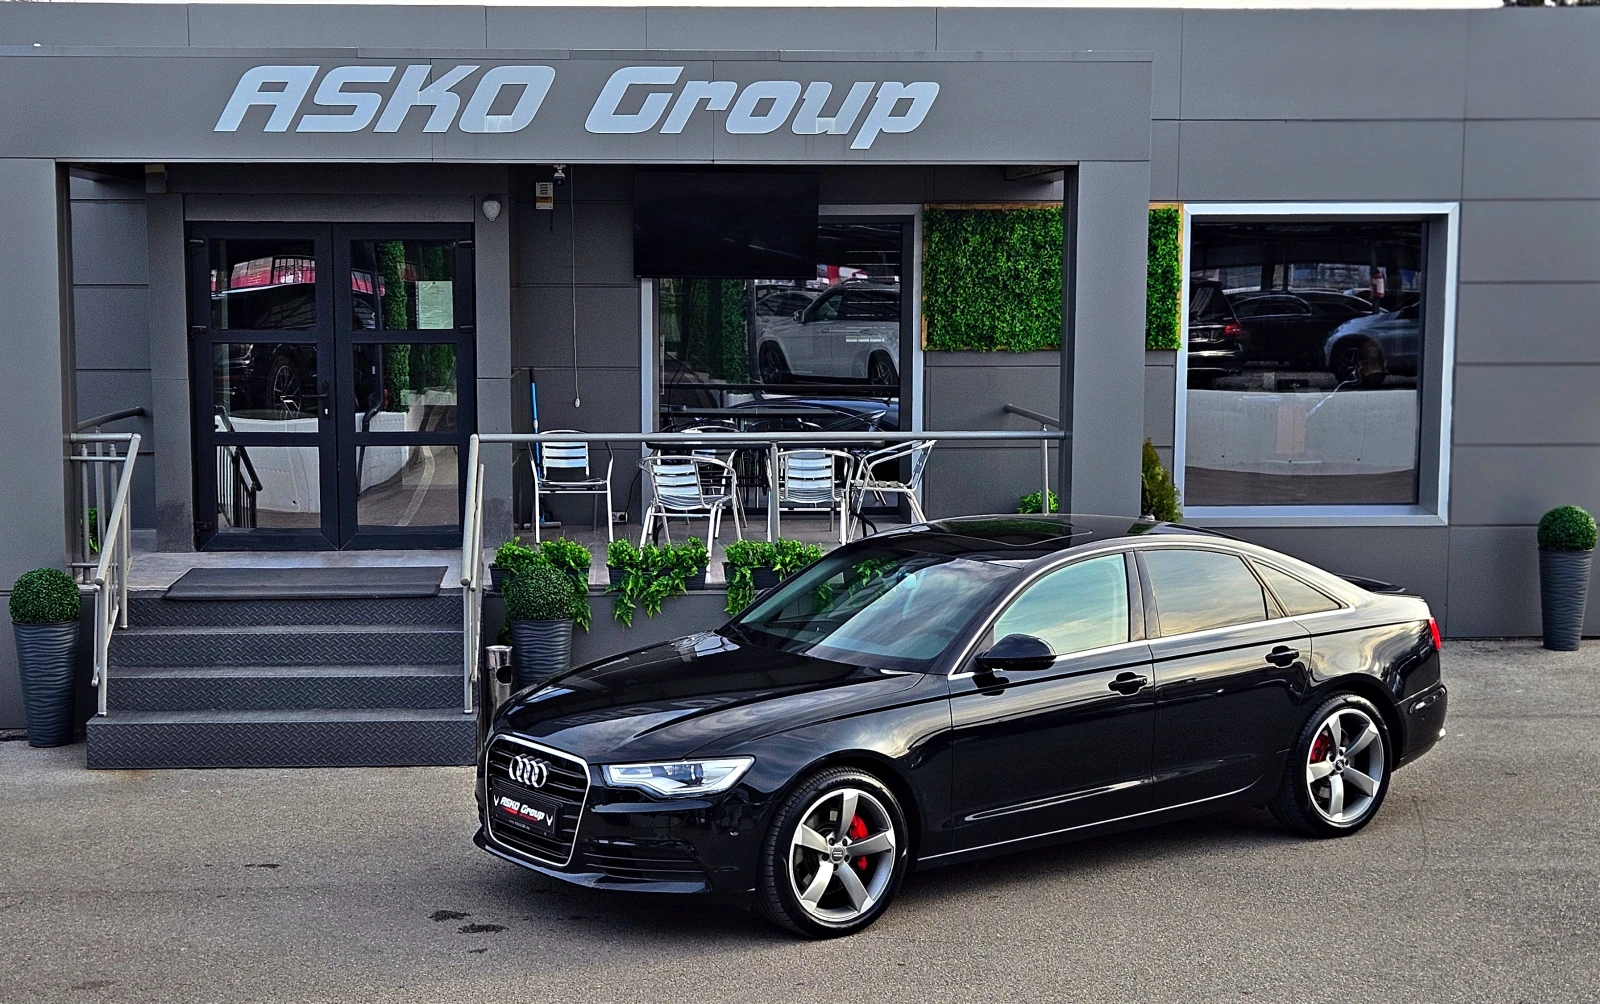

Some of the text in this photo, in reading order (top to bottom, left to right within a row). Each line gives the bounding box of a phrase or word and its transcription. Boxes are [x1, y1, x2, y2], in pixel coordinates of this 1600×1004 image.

[214, 65, 940, 150] ASKO Group
[500, 797, 545, 821] ASKO Group
